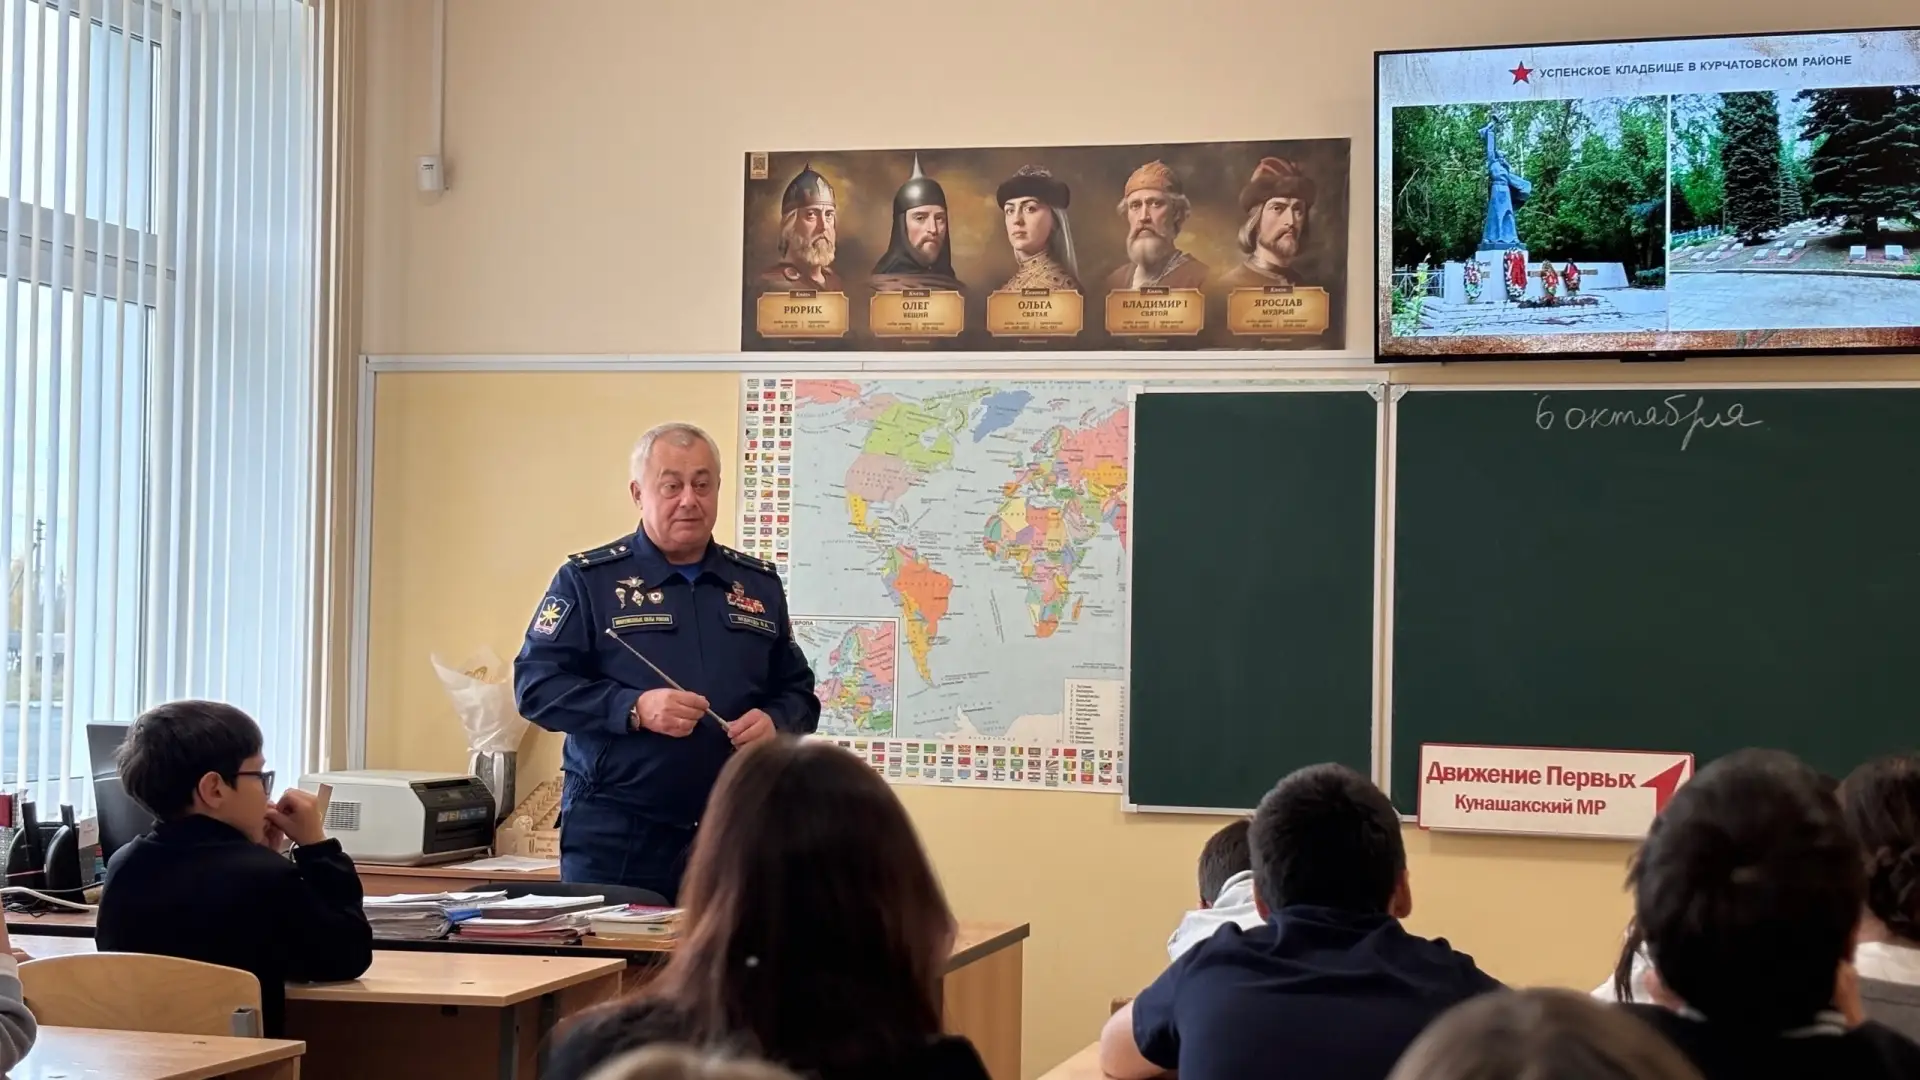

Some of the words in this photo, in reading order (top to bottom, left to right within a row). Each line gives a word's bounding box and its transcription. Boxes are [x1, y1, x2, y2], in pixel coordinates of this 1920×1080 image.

[1539, 66, 1611, 78] УСПЕНСКОЕ
[1615, 63, 1684, 76] КЛАДБИЩЕ
[1688, 63, 1696, 72] В
[1700, 57, 1798, 72] КУРЧАТОВСКОМ
[1803, 55, 1852, 67] РАЙОНЕ
[902, 301, 930, 310] ОЛЕГ
[1018, 300, 1052, 309] ОЛЬГА
[1122, 299, 1182, 309] ВЛАДИМИР
[1254, 298, 1303, 307] ЯРОСЛАВ
[783, 305, 823, 314] РЮРИК
[1262, 308, 1295, 316] МУДРЫЙ
[1535, 394, 1555, 430] 6
[1564, 393, 1764, 451] октября
[1426, 761, 1541, 785] Движение
[1546, 765, 1636, 791] Первых
[1454, 794, 1573, 815] Кунашакский
[1576, 799, 1607, 815] МР
